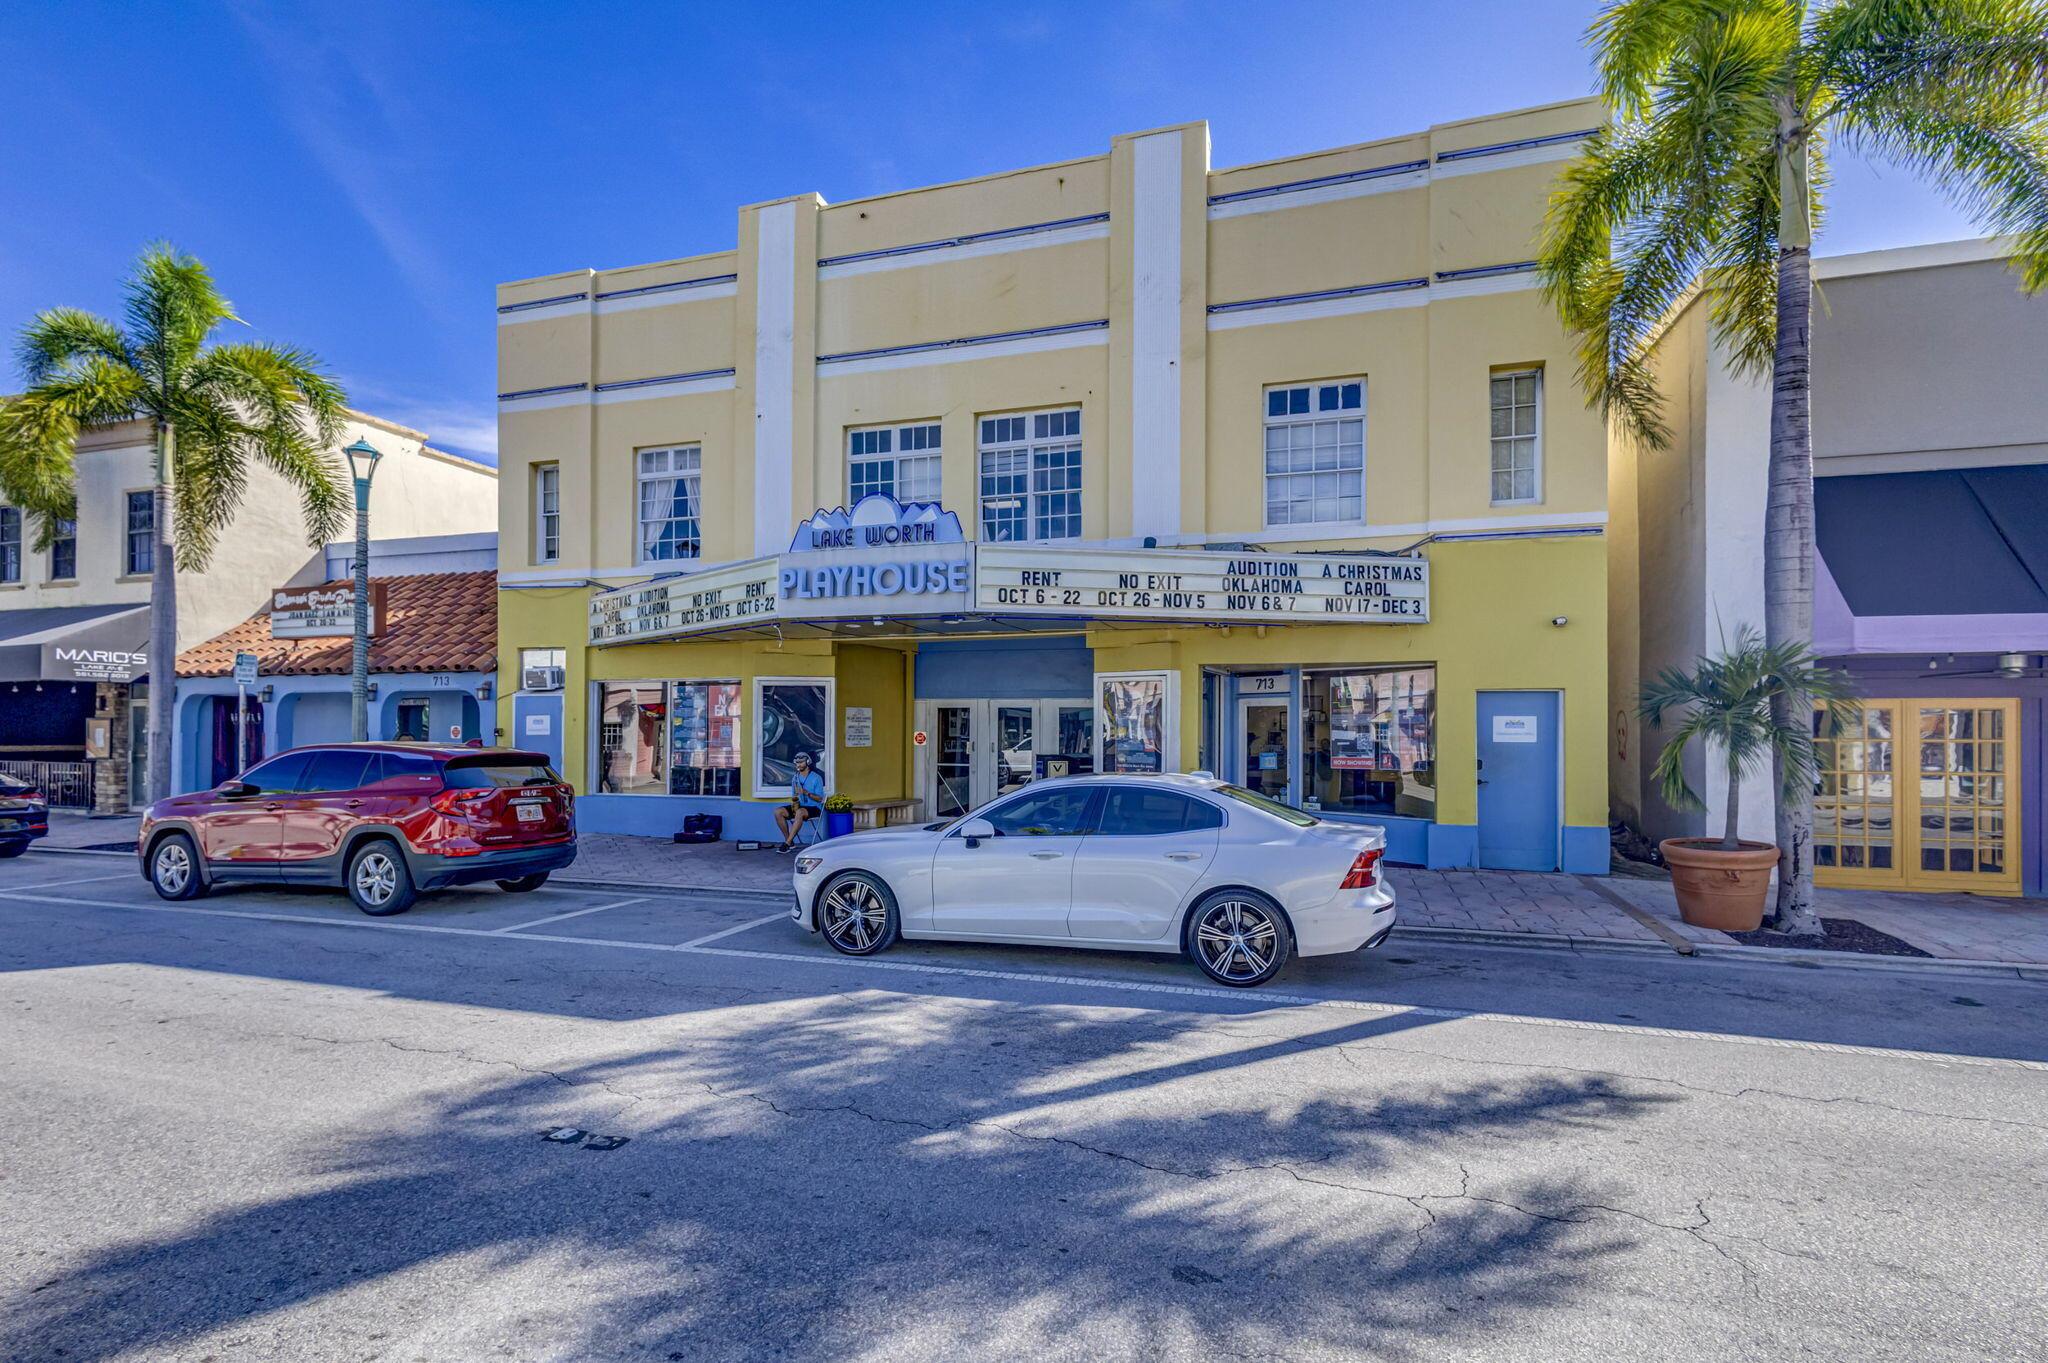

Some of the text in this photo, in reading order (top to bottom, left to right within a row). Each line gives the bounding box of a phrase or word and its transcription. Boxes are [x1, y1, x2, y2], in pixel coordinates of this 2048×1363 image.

[811, 523, 935, 548] LAKE WORTH
[1227, 561, 1297, 577] AUDITION
[1322, 564, 1422, 581] A CHRISTMAS
[779, 560, 969, 600] PLAYHOUSE
[1022, 571, 1061, 586] RENT
[1119, 574, 1182, 590] NO EXIT
[1222, 577, 1303, 594] OKLAHOMA
[746, 582, 767, 598] RENT
[998, 588, 1029, 603] OCT
[1344, 581, 1391, 597] CAROL
[693, 590, 722, 608] NO EXIT
[1097, 591, 1127, 606] OCT
[1227, 595, 1256, 610] NOV
[1289, 597, 1296, 611] 7
[1325, 598, 1352, 612] NOV
[1413, 600, 1421, 614] 3
[637, 601, 670, 618] OKLAHOMA
[737, 601, 752, 615] OCT
[681, 610, 695, 625] OCT
[56, 647, 147, 664] MARIO'S
[433, 676, 450, 686] 713
[1255, 678, 1275, 690] 713
